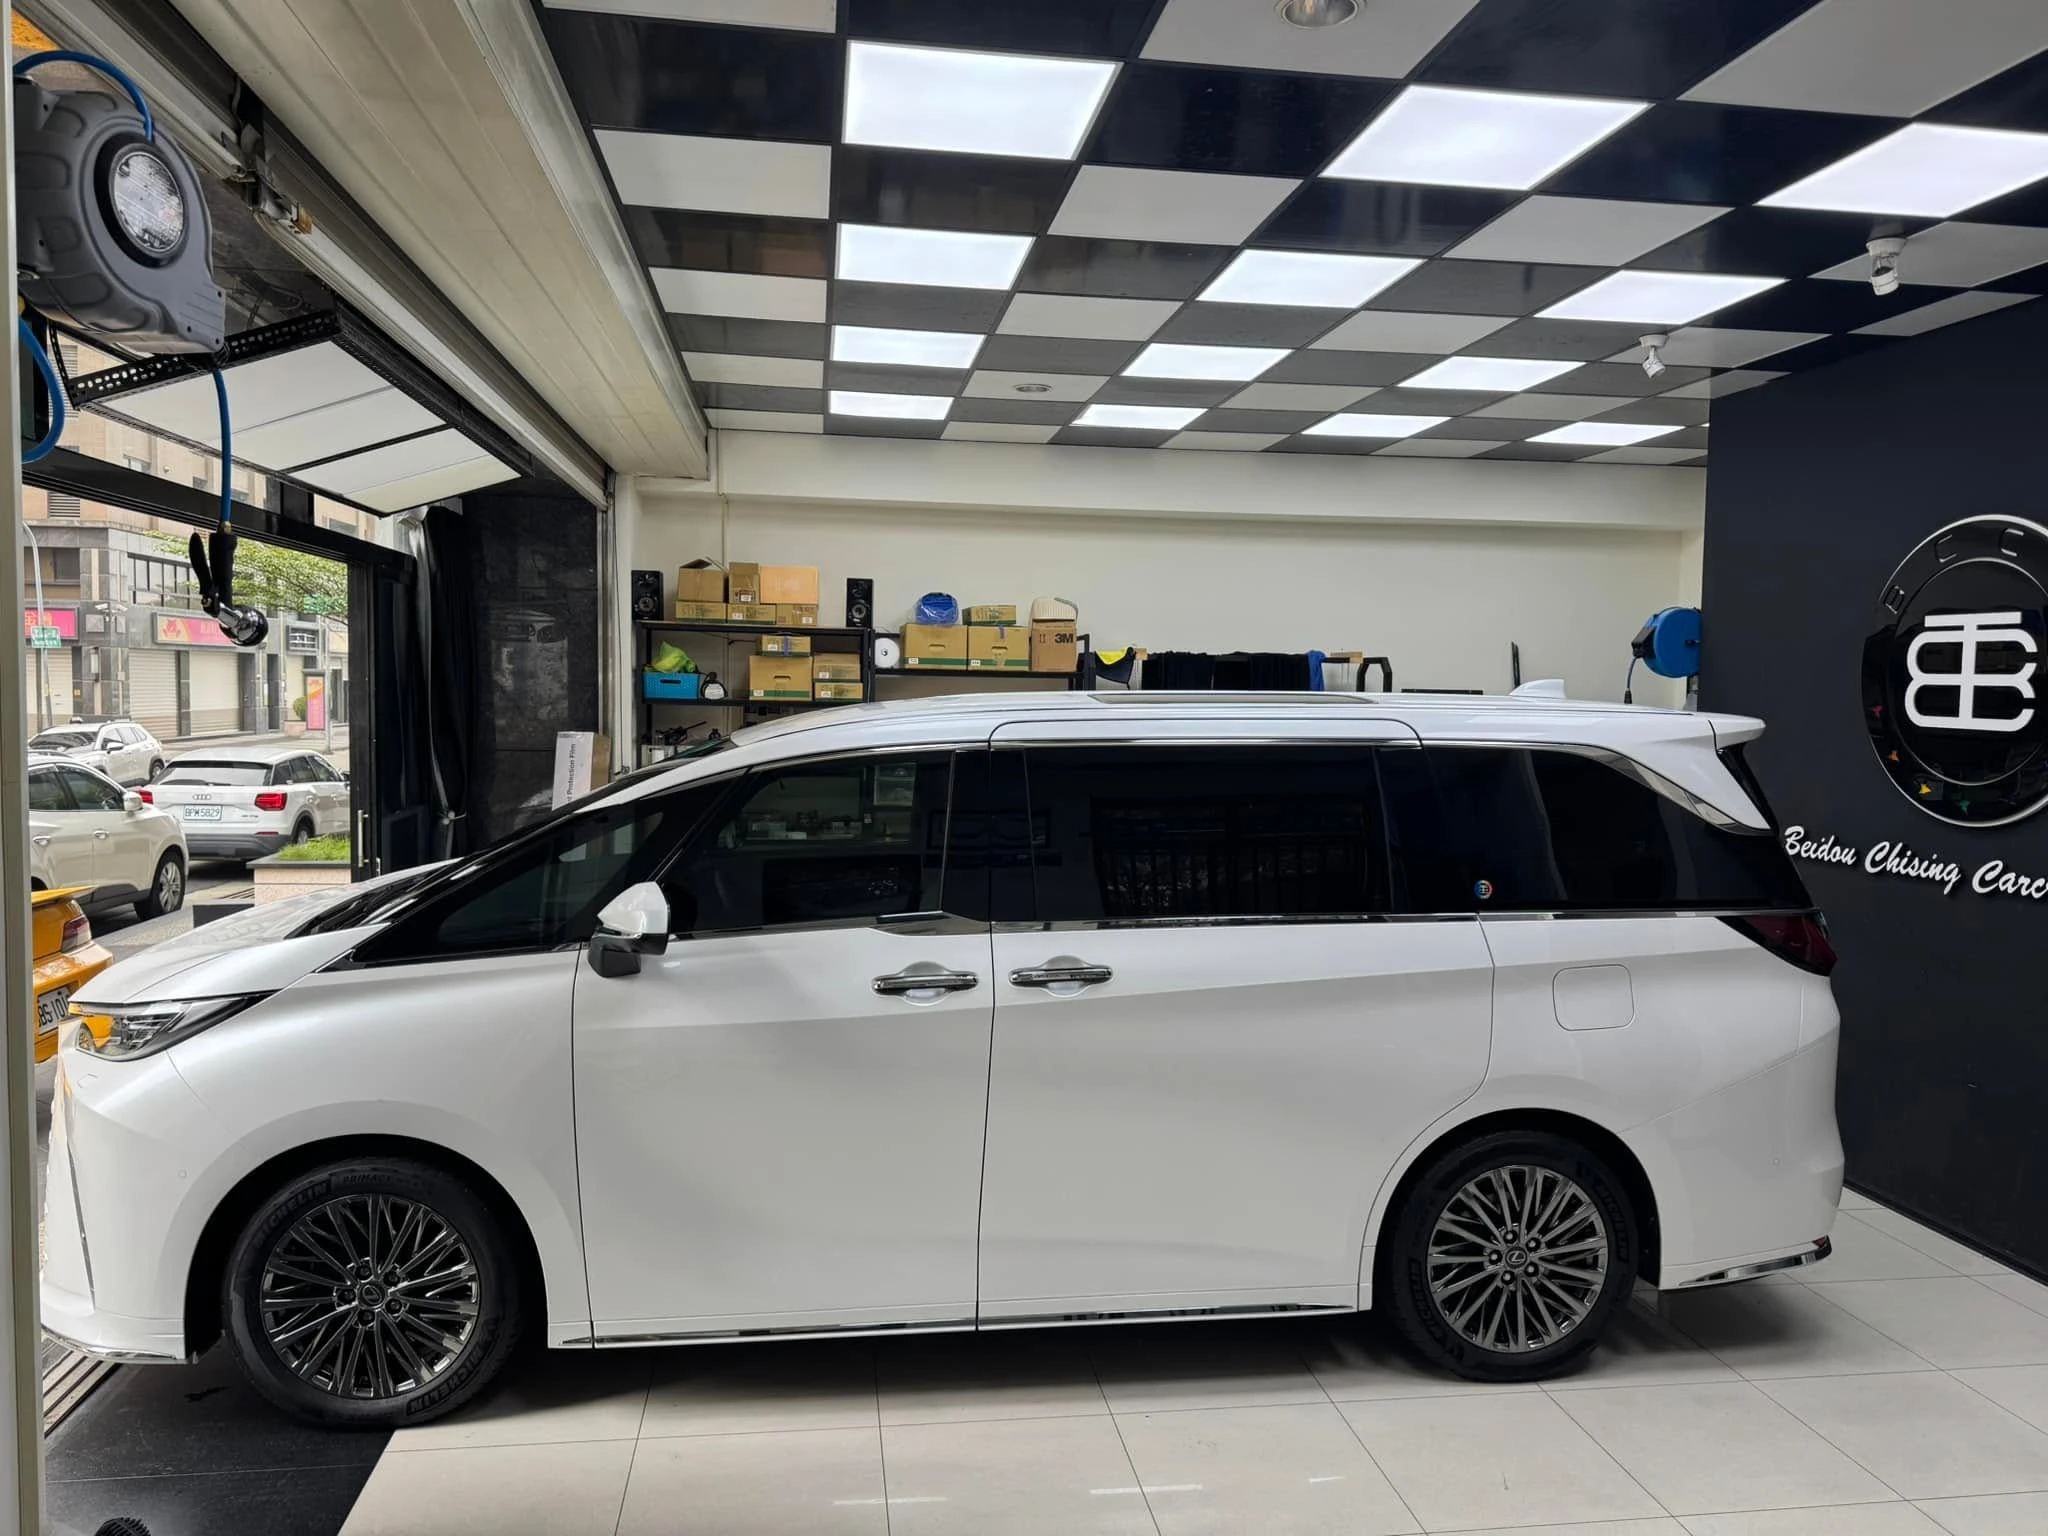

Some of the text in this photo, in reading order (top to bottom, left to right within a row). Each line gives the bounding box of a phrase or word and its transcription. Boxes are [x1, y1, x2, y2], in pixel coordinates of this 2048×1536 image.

[1055, 632, 1074, 644] 3M
[569, 743, 577, 759] Film
[567, 760, 575, 795] Protection
[1784, 825, 2048, 899] Beidou Chising Carc
